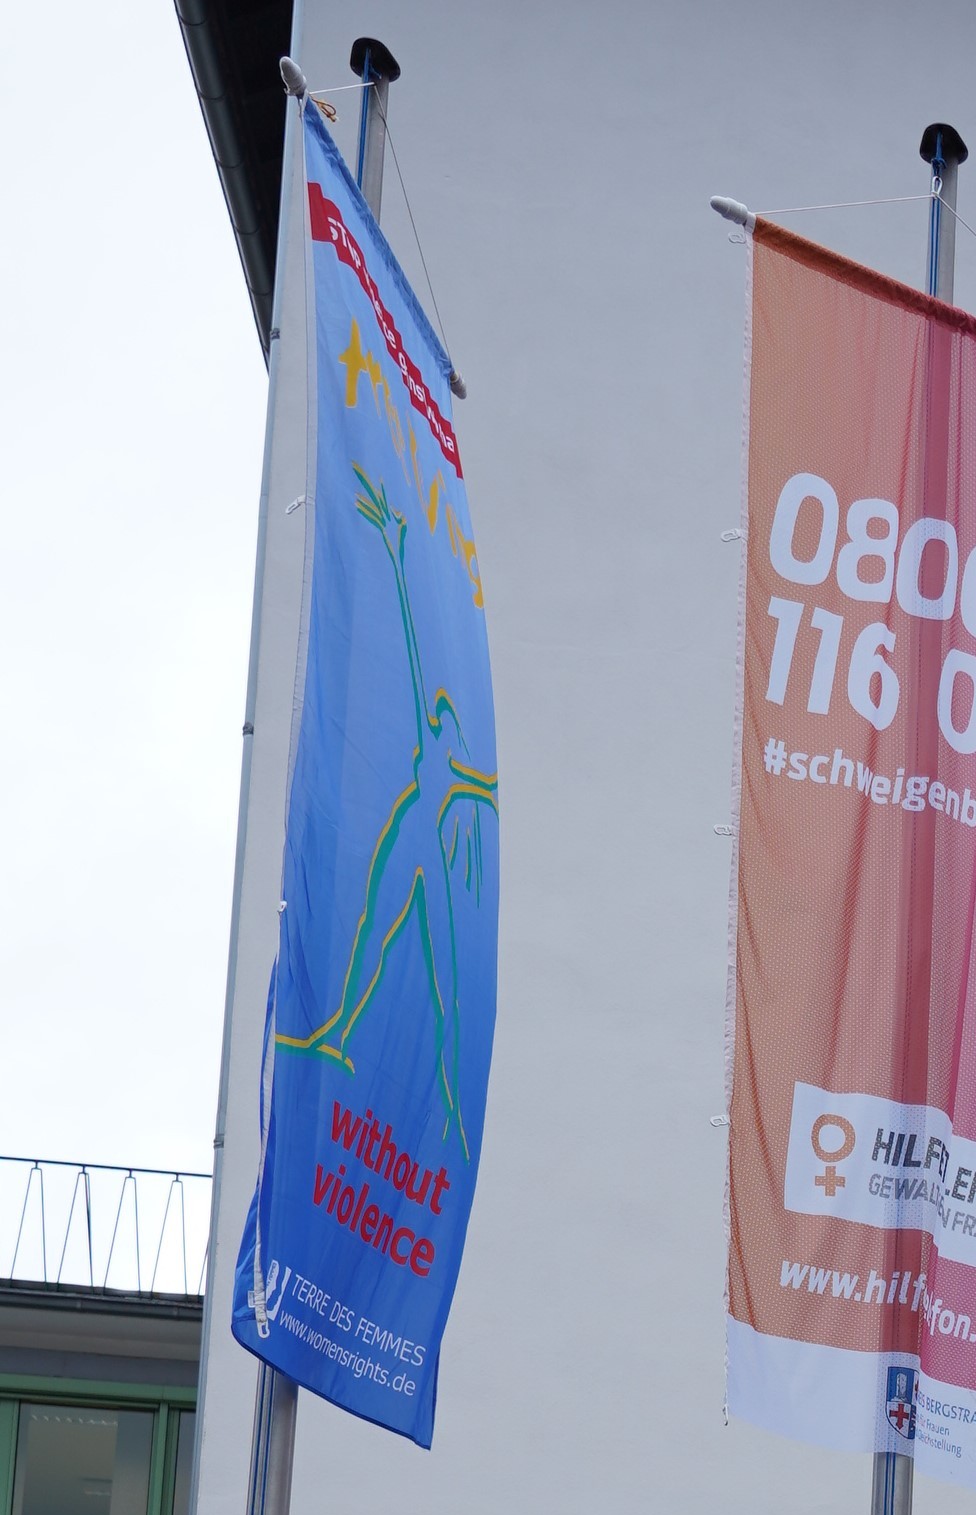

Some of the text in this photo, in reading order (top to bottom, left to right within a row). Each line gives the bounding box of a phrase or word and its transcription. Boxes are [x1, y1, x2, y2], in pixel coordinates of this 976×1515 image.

[766, 596, 900, 730] 116
[331, 1101, 451, 1216] without
[312, 1164, 436, 1278] violence
[280, 1311, 416, 1397] www.womensrights.de
[292, 1274, 329, 1318] TERRE
[329, 1306, 353, 1332] DES
[355, 1319, 427, 1367] FEMMES
[926, 1418, 951, 1437] Frauen
